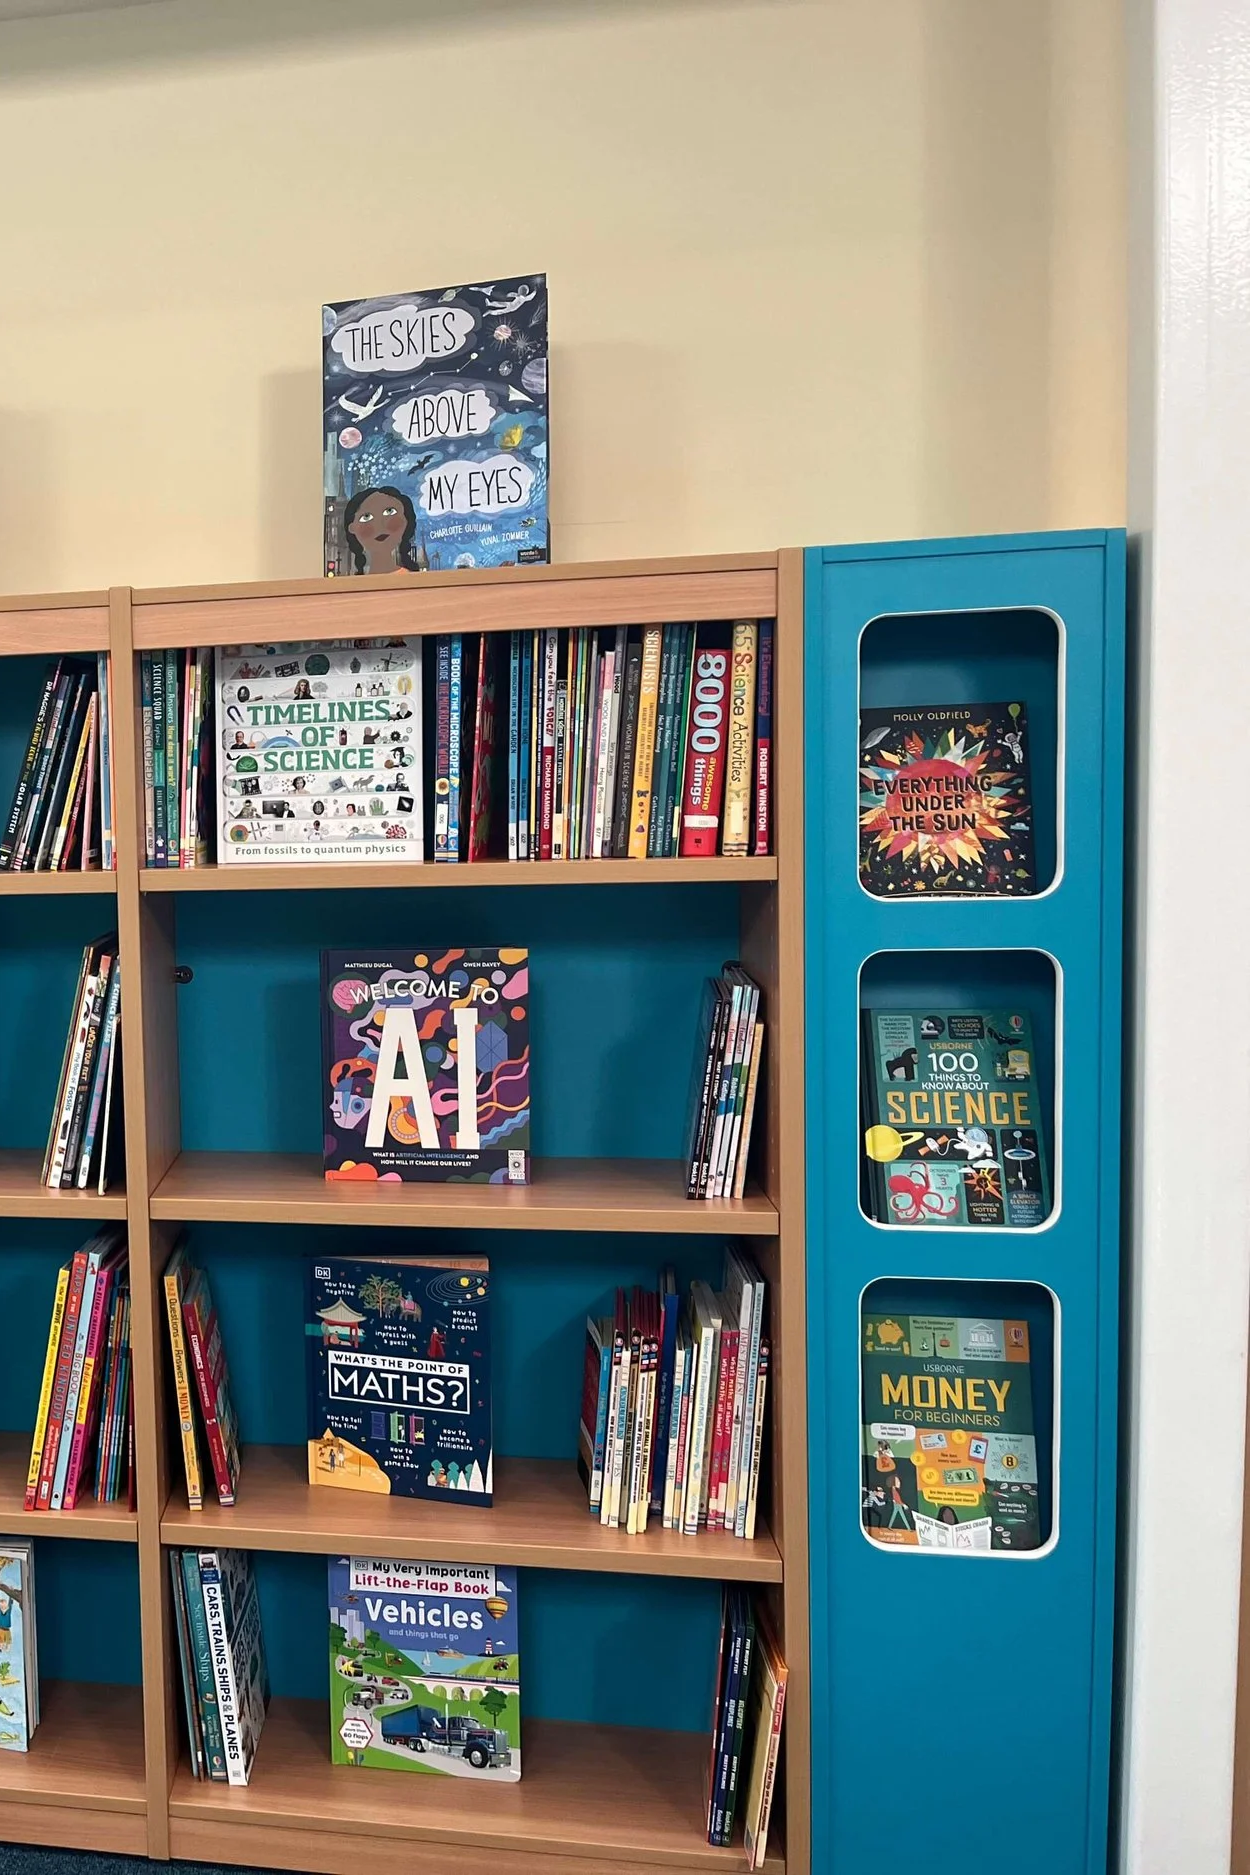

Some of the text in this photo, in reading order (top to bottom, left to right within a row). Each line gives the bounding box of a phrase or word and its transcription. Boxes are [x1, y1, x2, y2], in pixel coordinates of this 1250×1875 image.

[345, 312, 457, 362] THE SKIES
[408, 393, 478, 439] ABOVE
[428, 467, 523, 510] MY EYES
[643, 630, 659, 695] SCIENTISTS
[153, 663, 162, 720] SCIENCE SQUAD
[247, 700, 391, 726] TIMELINES
[449, 658, 461, 774] BOOK THE MICROSCOPE
[893, 711, 971, 722] MOLLY OLDFIELD
[301, 726, 334, 747] OF
[691, 651, 727, 811] 8000 awesome things
[264, 748, 374, 772] SCIENCE
[621, 723, 633, 788] WOMEN SCIENCE
[543, 755, 552, 830] RICHARD HAMMOND
[759, 747, 768, 832] ROBERT WINSTON
[872, 775, 993, 797] EVERYTHING
[901, 795, 966, 813] UNDER
[889, 813, 977, 832] THE SUN
[236, 844, 406, 856] From fossils to quantum physics
[350, 979, 499, 1005] WELCOME TO
[929, 1042, 974, 1050] USBORNE
[927, 1052, 979, 1073] 100
[364, 1007, 481, 1150] AI
[921, 1082, 990, 1091] KNOW ABOUT
[928, 1074, 981, 1082] THINGS TO
[886, 1091, 1031, 1125] SCIENCE
[68, 1353, 84, 1395] BIG BOOK
[334, 1353, 464, 1374] WHAT'S THE POINT OF
[923, 1364, 965, 1374] USBORNE
[333, 1366, 465, 1407] MATHS?
[881, 1373, 1011, 1413] MONEY
[894, 1409, 1000, 1426] FOR BEGINNERS
[372, 1562, 491, 1580] My Very Important
[354, 1574, 490, 1595] Lift-the-Flap Book
[365, 1598, 484, 1630] Vehicles
[388, 1628, 459, 1642] and things that go
[206, 1586, 239, 1760] CARS, TRAINS, SHIPS PLANES
